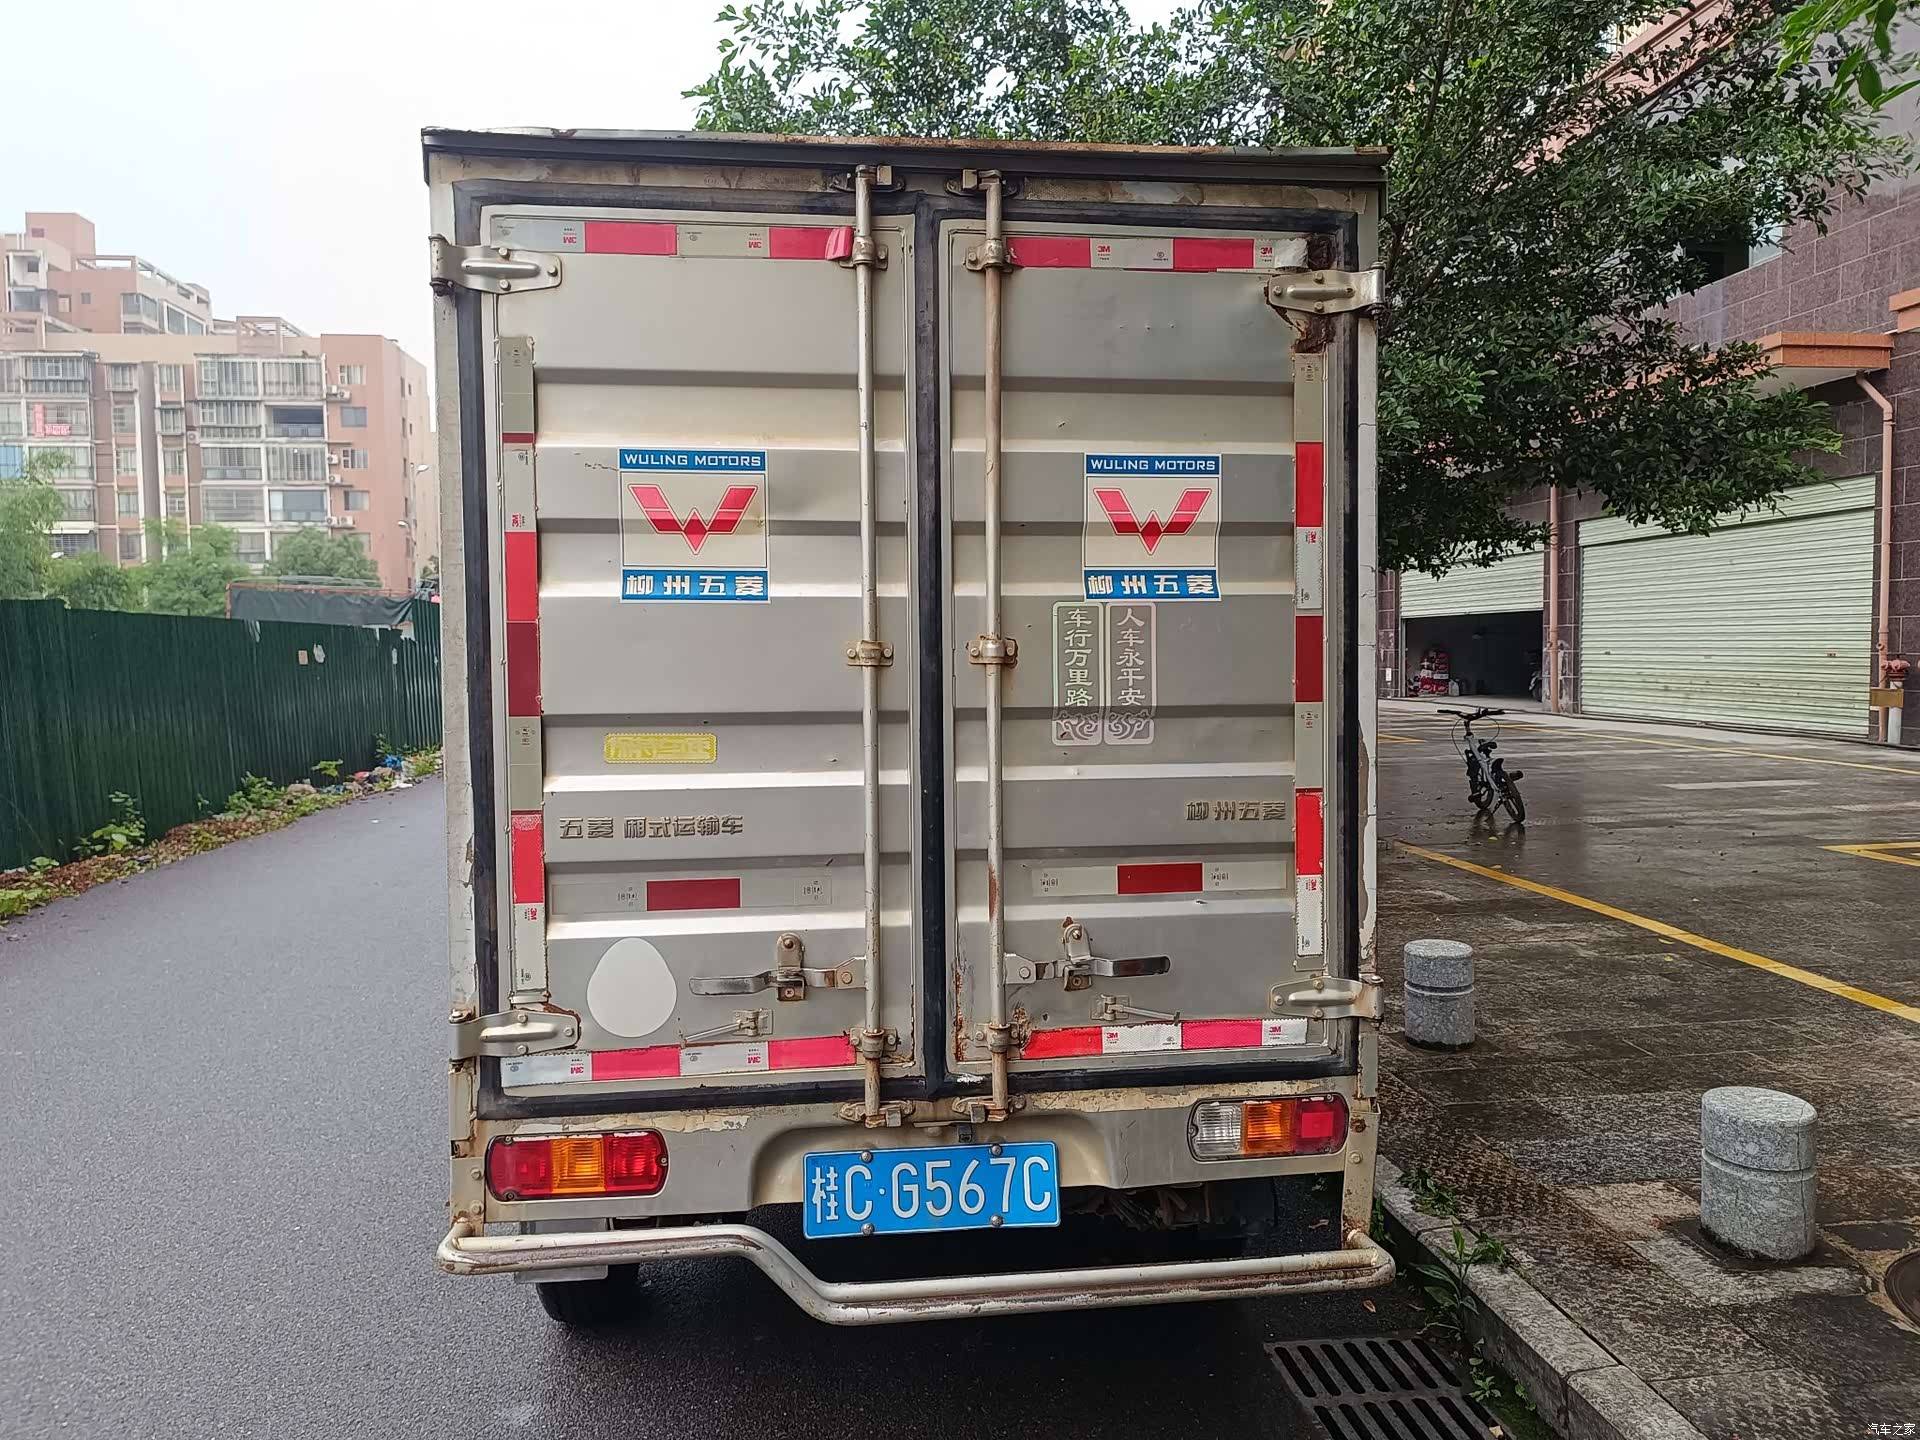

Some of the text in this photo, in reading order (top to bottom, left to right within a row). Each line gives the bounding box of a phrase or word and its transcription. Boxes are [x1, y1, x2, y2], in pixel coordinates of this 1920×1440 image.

[562, 236, 577, 244] 3M
[748, 240, 762, 249] 3M
[1097, 245, 1111, 253] 3M
[1260, 246, 1273, 255] 3M
[624, 454, 762, 467] WULING MOTORS
[1090, 459, 1216, 471] WULING MOTORS
[512, 514, 519, 527] 3M
[1310, 531, 1317, 544] 3M
[625, 574, 764, 596] 柳州五菱
[1087, 574, 1215, 595] 柳州五菱
[1063, 607, 1094, 707] 车行万里路
[1115, 607, 1146, 706] 人车永平安
[1186, 801, 1286, 821] 柳州五菱
[559, 814, 744, 839] 五菱 厢式运输车
[1311, 879, 1317, 891] 3M
[530, 907, 537, 920] 3M
[747, 1056, 761, 1064] 3M
[570, 1066, 584, 1075] 3M
[812, 1156, 1051, 1224] 桂C·G567C
